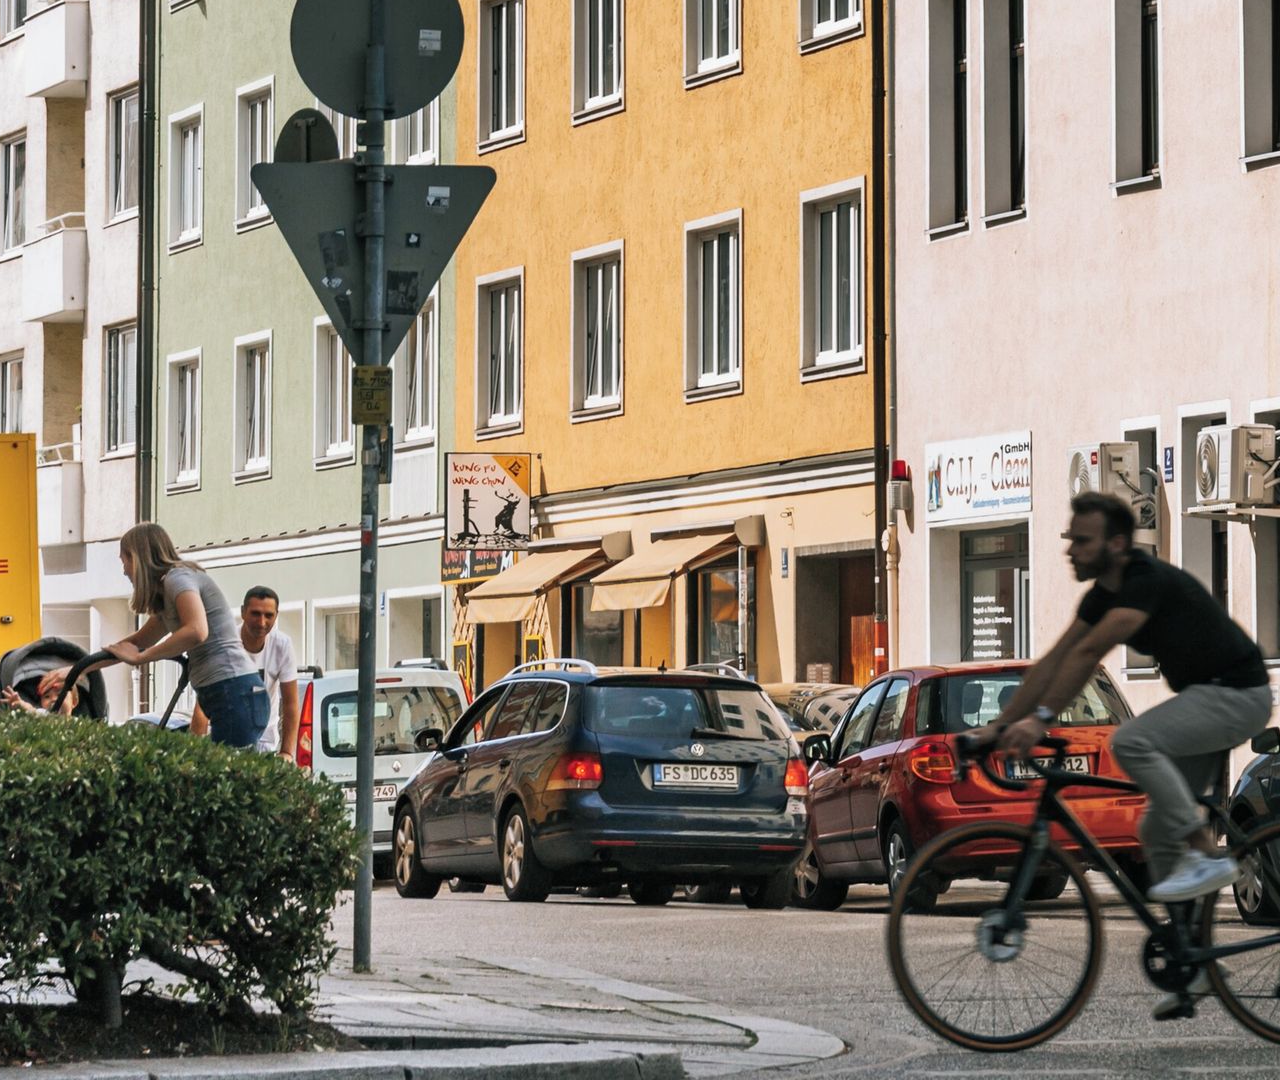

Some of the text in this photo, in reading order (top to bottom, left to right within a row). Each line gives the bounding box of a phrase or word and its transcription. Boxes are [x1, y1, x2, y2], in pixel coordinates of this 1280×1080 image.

[1004, 442, 1030, 454] GmbH
[991, 444, 1031, 491] Clean
[1062, 758, 1084, 772] 12
[662, 765, 681, 780] FS
[373, 786, 395, 798] 749
